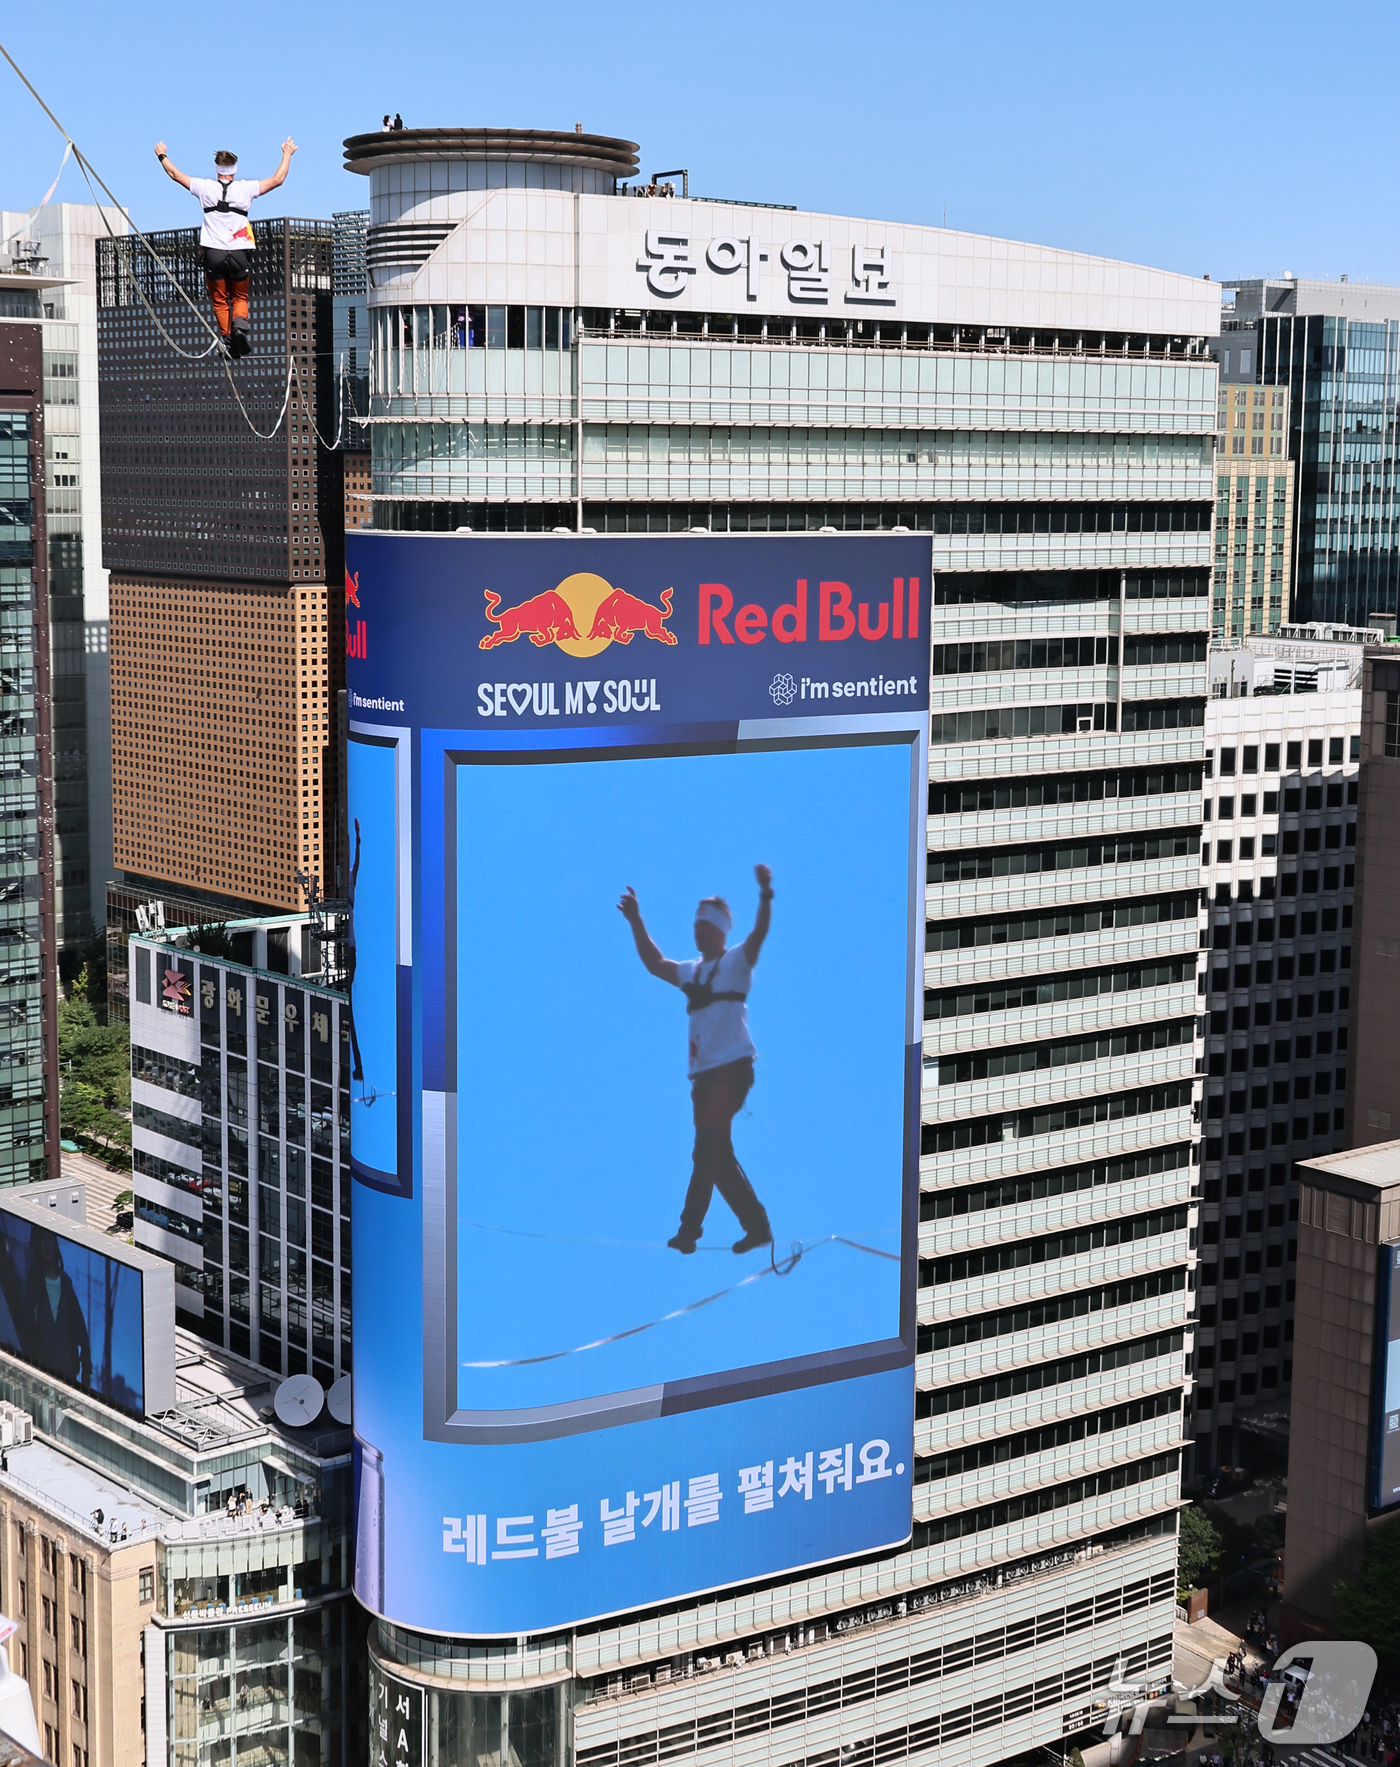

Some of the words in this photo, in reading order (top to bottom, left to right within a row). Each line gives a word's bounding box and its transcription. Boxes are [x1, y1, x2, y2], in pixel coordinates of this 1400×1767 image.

[637, 229, 899, 305] 동아일보
[698, 579, 808, 646] Red
[819, 577, 919, 641] Bull
[362, 697, 405, 712] sentient
[832, 675, 917, 698] sentient
[443, 1503, 584, 1566] 레드불
[600, 1472, 723, 1547] 날개를
[738, 1438, 905, 1515] 펼쳐줘요.
[182, 1606, 224, 1620] 신문박물관
[226, 1600, 272, 1615] PRESSEUM
